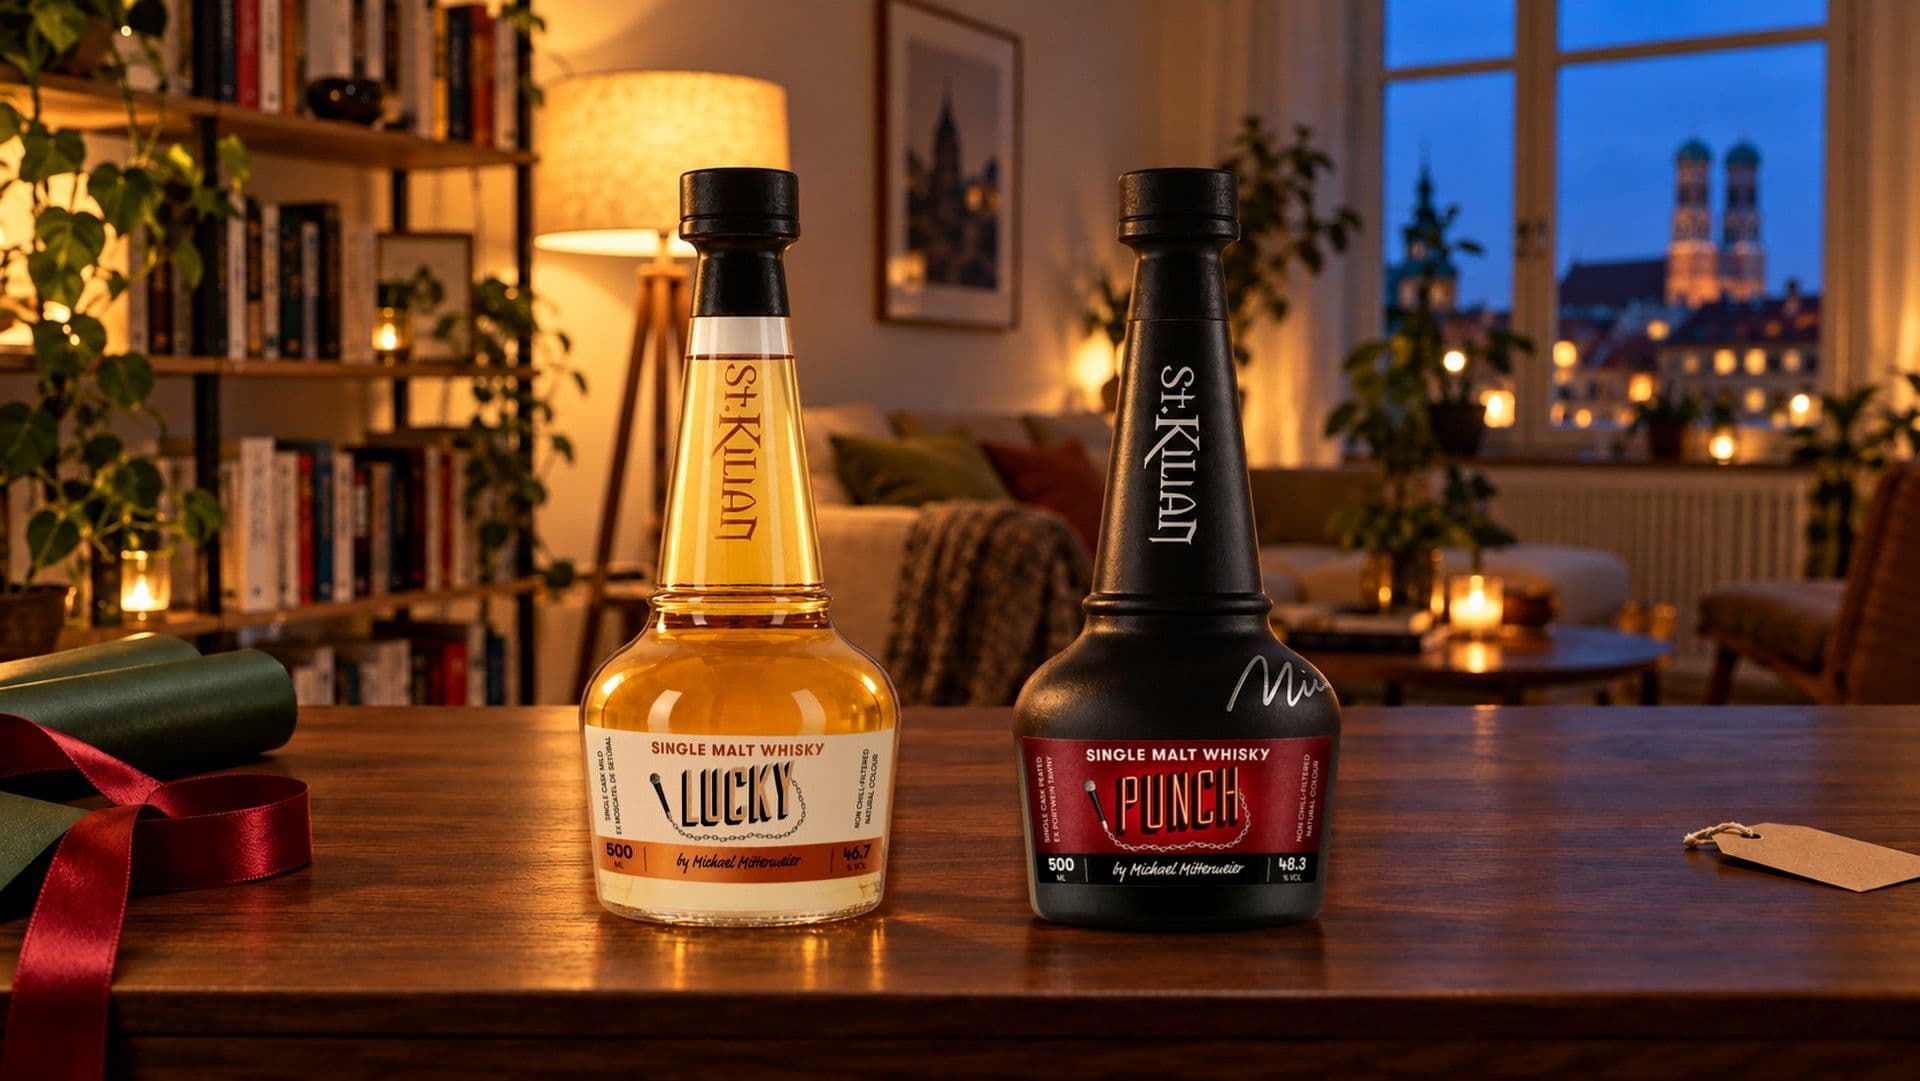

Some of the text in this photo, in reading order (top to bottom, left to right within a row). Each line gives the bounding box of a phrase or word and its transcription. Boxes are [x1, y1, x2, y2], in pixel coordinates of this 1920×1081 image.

[651, 741, 825, 757] SINGLE MALT WHISKY
[1086, 748, 1270, 762] SINGLE MALT WHISKY
[609, 773, 616, 784] DE
[1036, 756, 1044, 787] PEATED
[597, 750, 611, 821] SINGLE CASK MILD
[682, 760, 794, 827] LUCKY
[854, 748, 869, 829] NON CHILL-FILTERED
[865, 753, 878, 824] NATURAL COLOUR
[611, 785, 621, 825] MOSCATEL
[1046, 756, 1060, 843] EX PORTWEIN TAWNY
[1117, 766, 1239, 834] PUNCH
[1296, 754, 1310, 842] NON CHILL-FILTERED
[1306, 760, 1319, 837] NATURAL COLOUR
[615, 825, 622, 835] EX
[1042, 813, 1050, 843] SINGLE
[606, 842, 633, 859] 500
[843, 844, 871, 860] 46.7
[676, 853, 689, 874] by
[692, 853, 736, 869] Michael
[1048, 857, 1075, 872] 500
[1112, 861, 1127, 883] by
[1130, 861, 1178, 876] Michael
[1278, 857, 1306, 871] 48.3
[1056, 874, 1066, 882] ML
[1289, 874, 1302, 882] VOL
